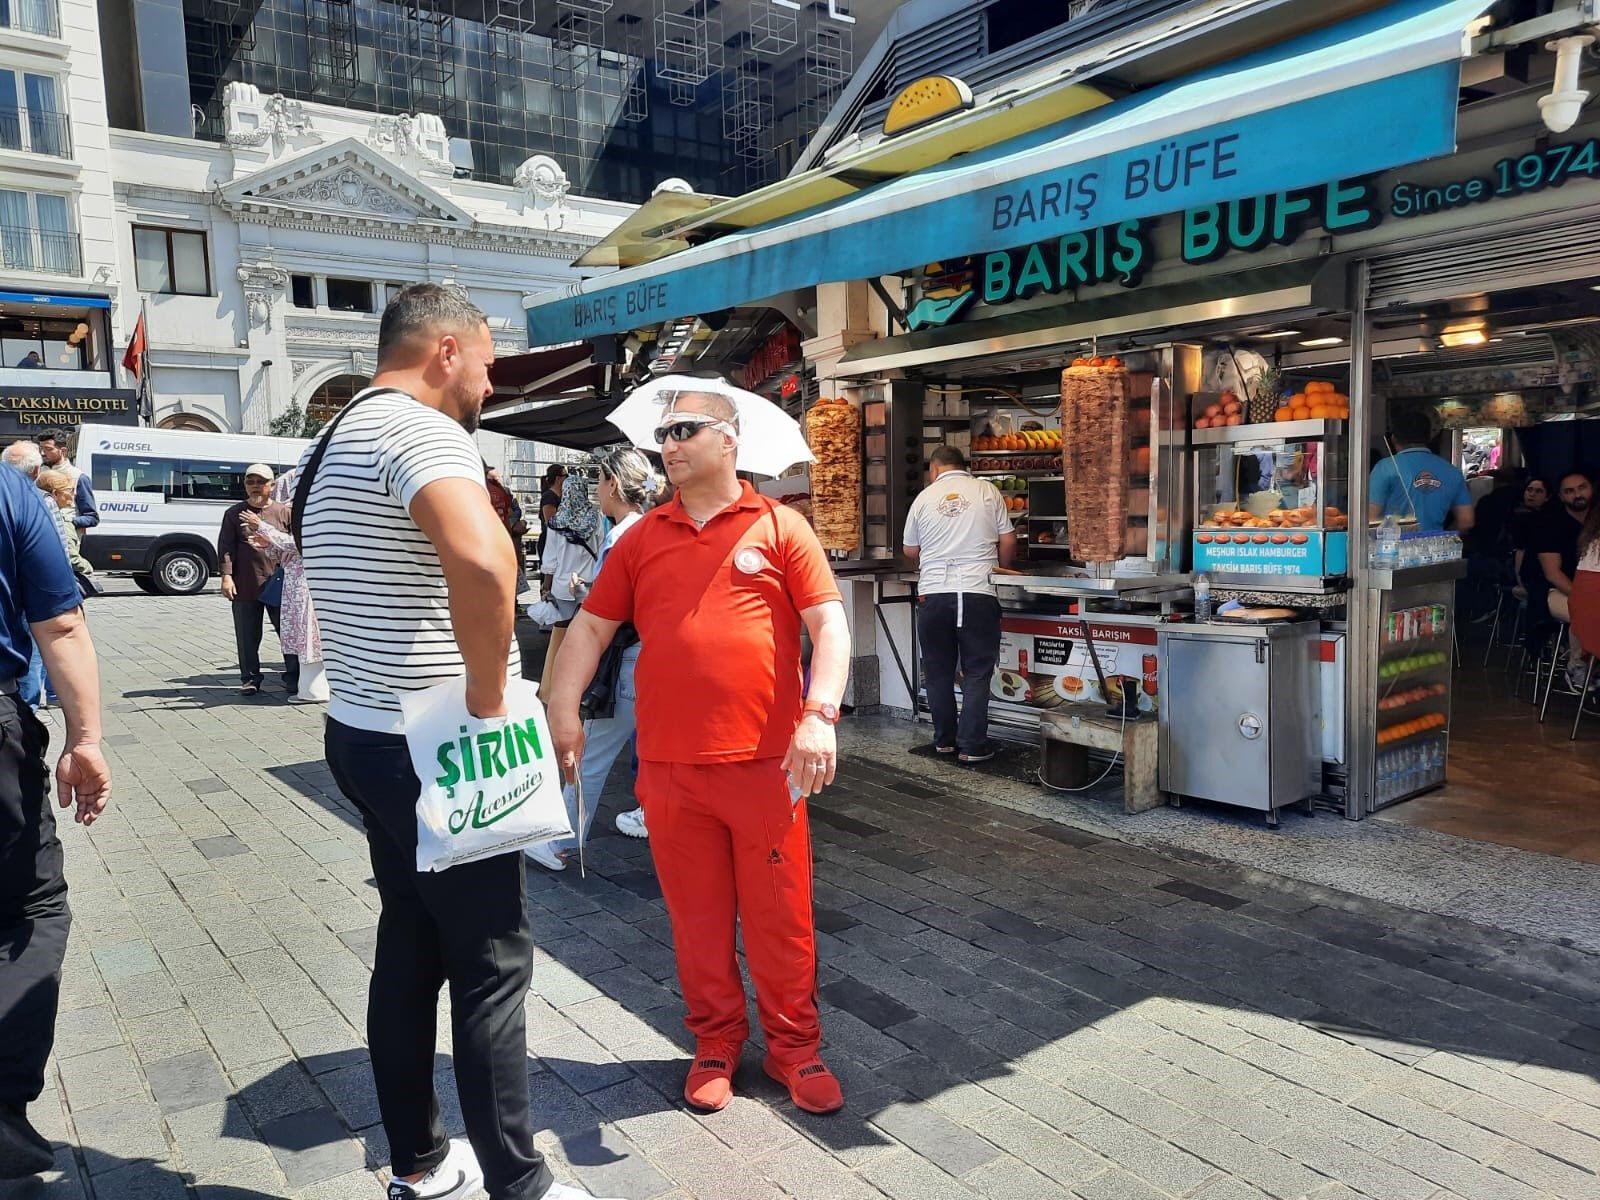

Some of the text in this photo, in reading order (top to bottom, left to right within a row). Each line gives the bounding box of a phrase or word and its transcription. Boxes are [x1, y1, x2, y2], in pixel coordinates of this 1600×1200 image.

[992, 133, 1239, 230] BARIŞ BÜFE
[983, 217, 1143, 302] BARIŞ
[1392, 176, 1483, 217] Since
[1494, 139, 1600, 198] 1974
[626, 282, 669, 316] BÜFE
[8, 395, 73, 410] TAKSİM
[72, 398, 128, 411] HOTEL
[113, 440, 152, 452] GÜRSEL
[99, 502, 149, 513] ONURLU
[1206, 546, 1307, 559] MEŞHUR ISLAK HAMBURGER
[1263, 562, 1282, 575] BÜFE
[1283, 565, 1301, 575] 1974
[1057, 626, 1130, 640] TAKSİ BARIŞIM
[448, 771, 544, 835] Accessories
